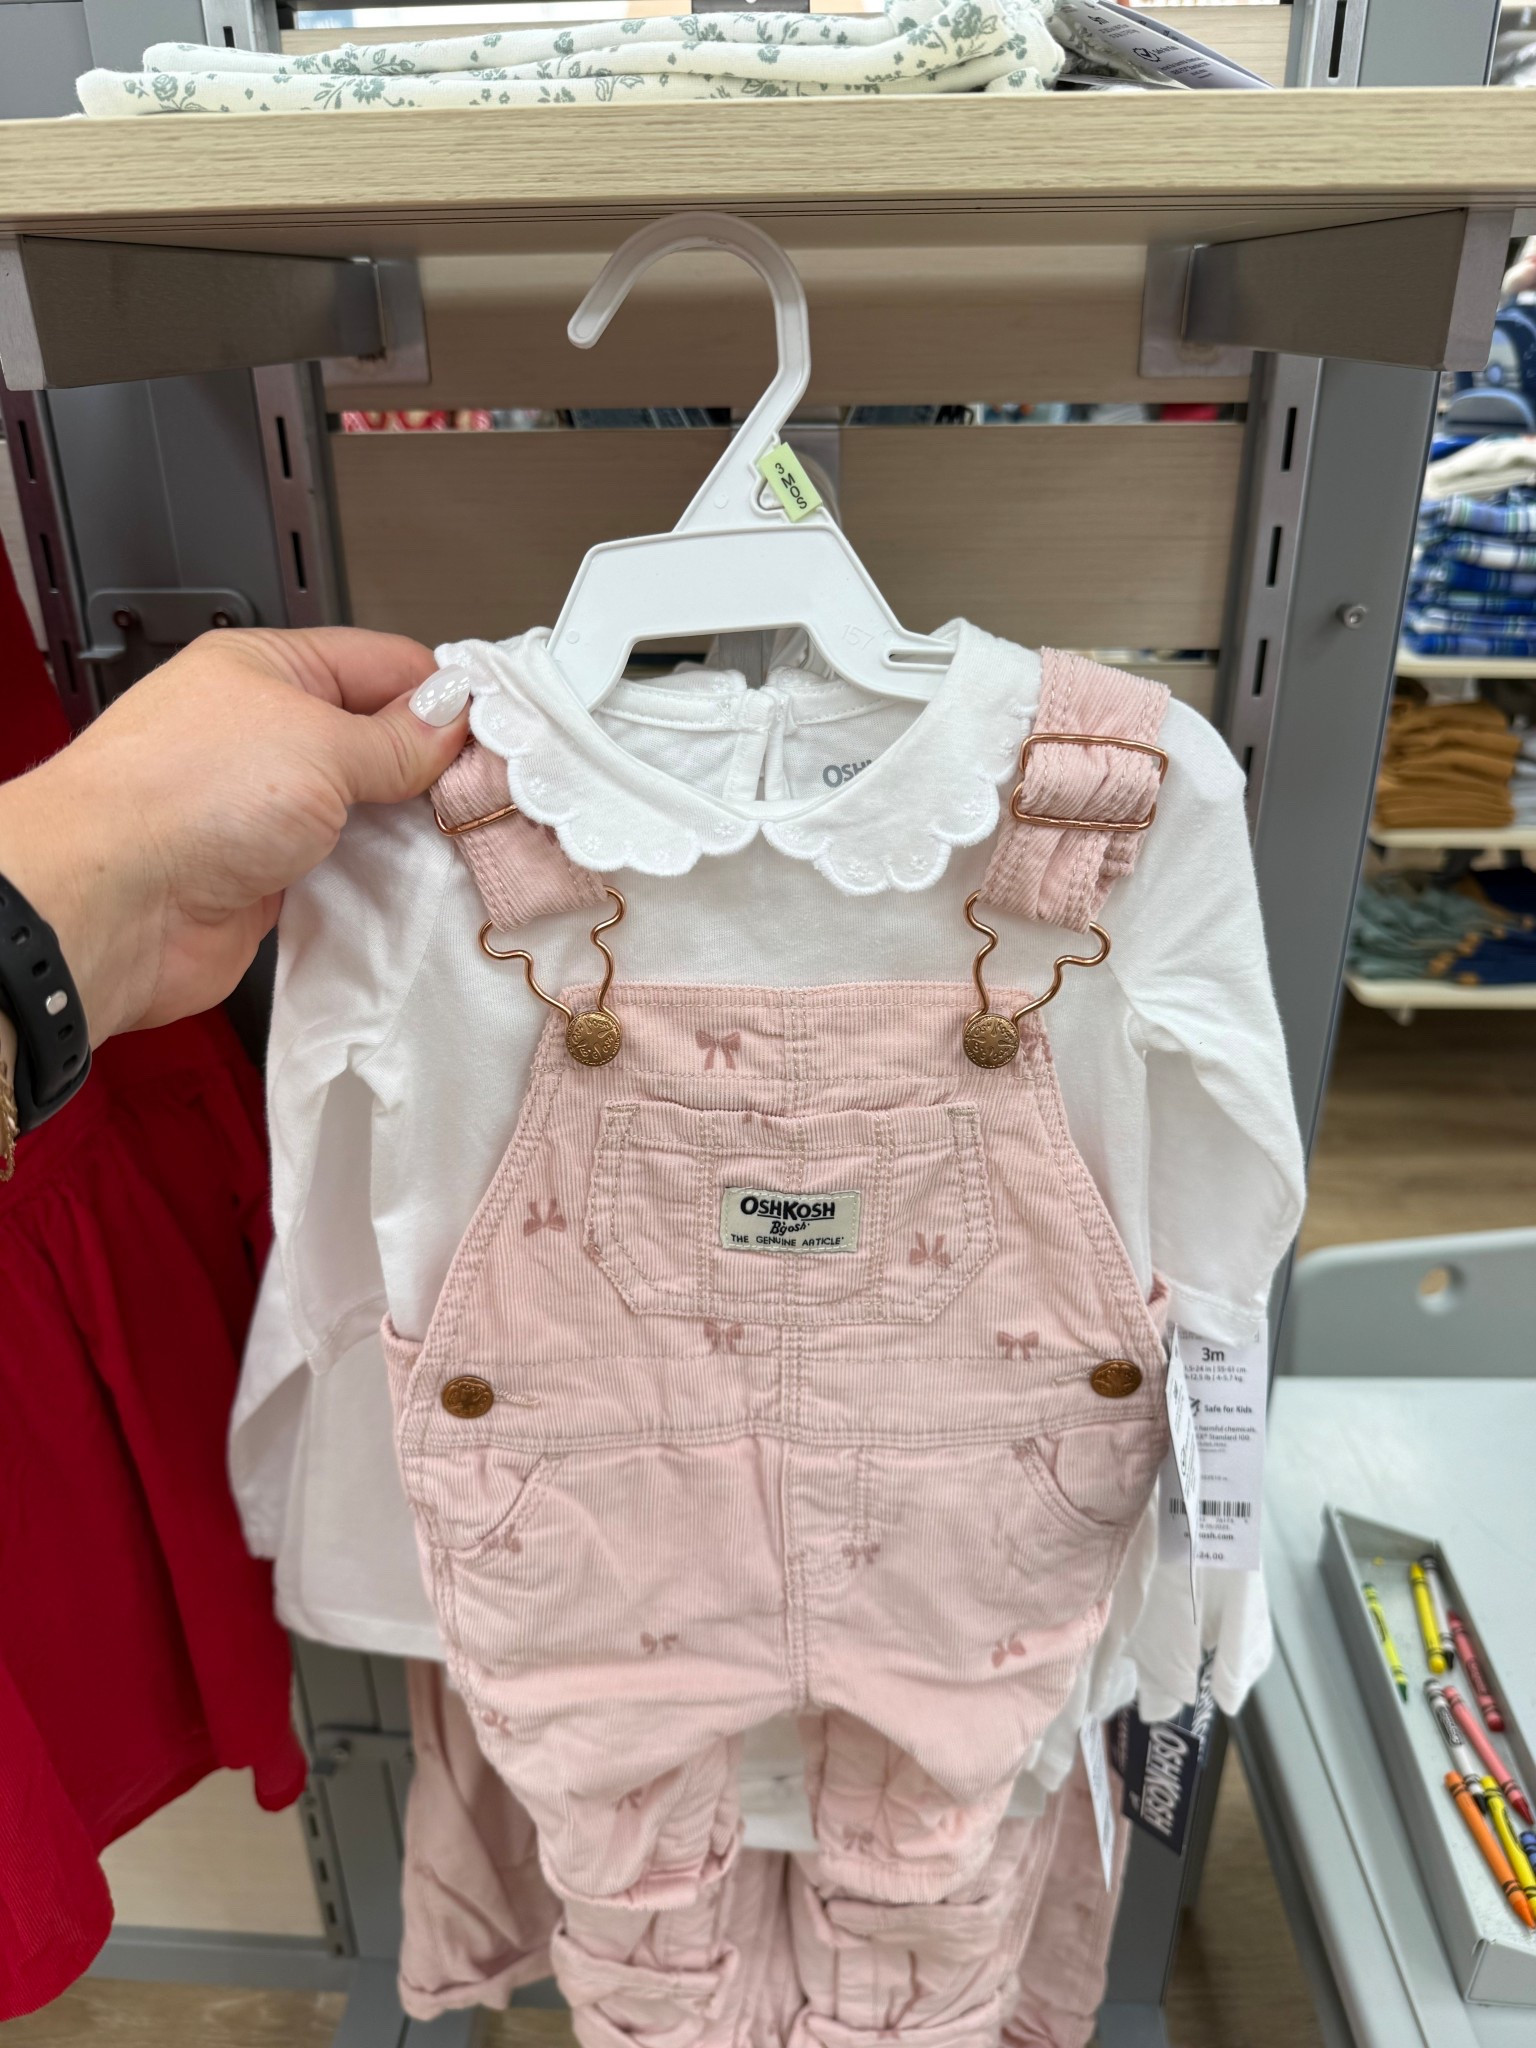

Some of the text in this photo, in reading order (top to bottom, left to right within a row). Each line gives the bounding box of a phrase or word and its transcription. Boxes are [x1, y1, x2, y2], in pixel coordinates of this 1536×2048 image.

[775, 463, 807, 509] 3 MOS
[823, 760, 873, 788] OSH
[740, 1196, 836, 1221] OSHKOSH
[731, 1233, 841, 1247] THE GENUINE ARTICLE
[1202, 1347, 1225, 1361] 3m
[1204, 1404, 1253, 1414] Safe for Kids
[1142, 1723, 1190, 1838] OSHKOSH
